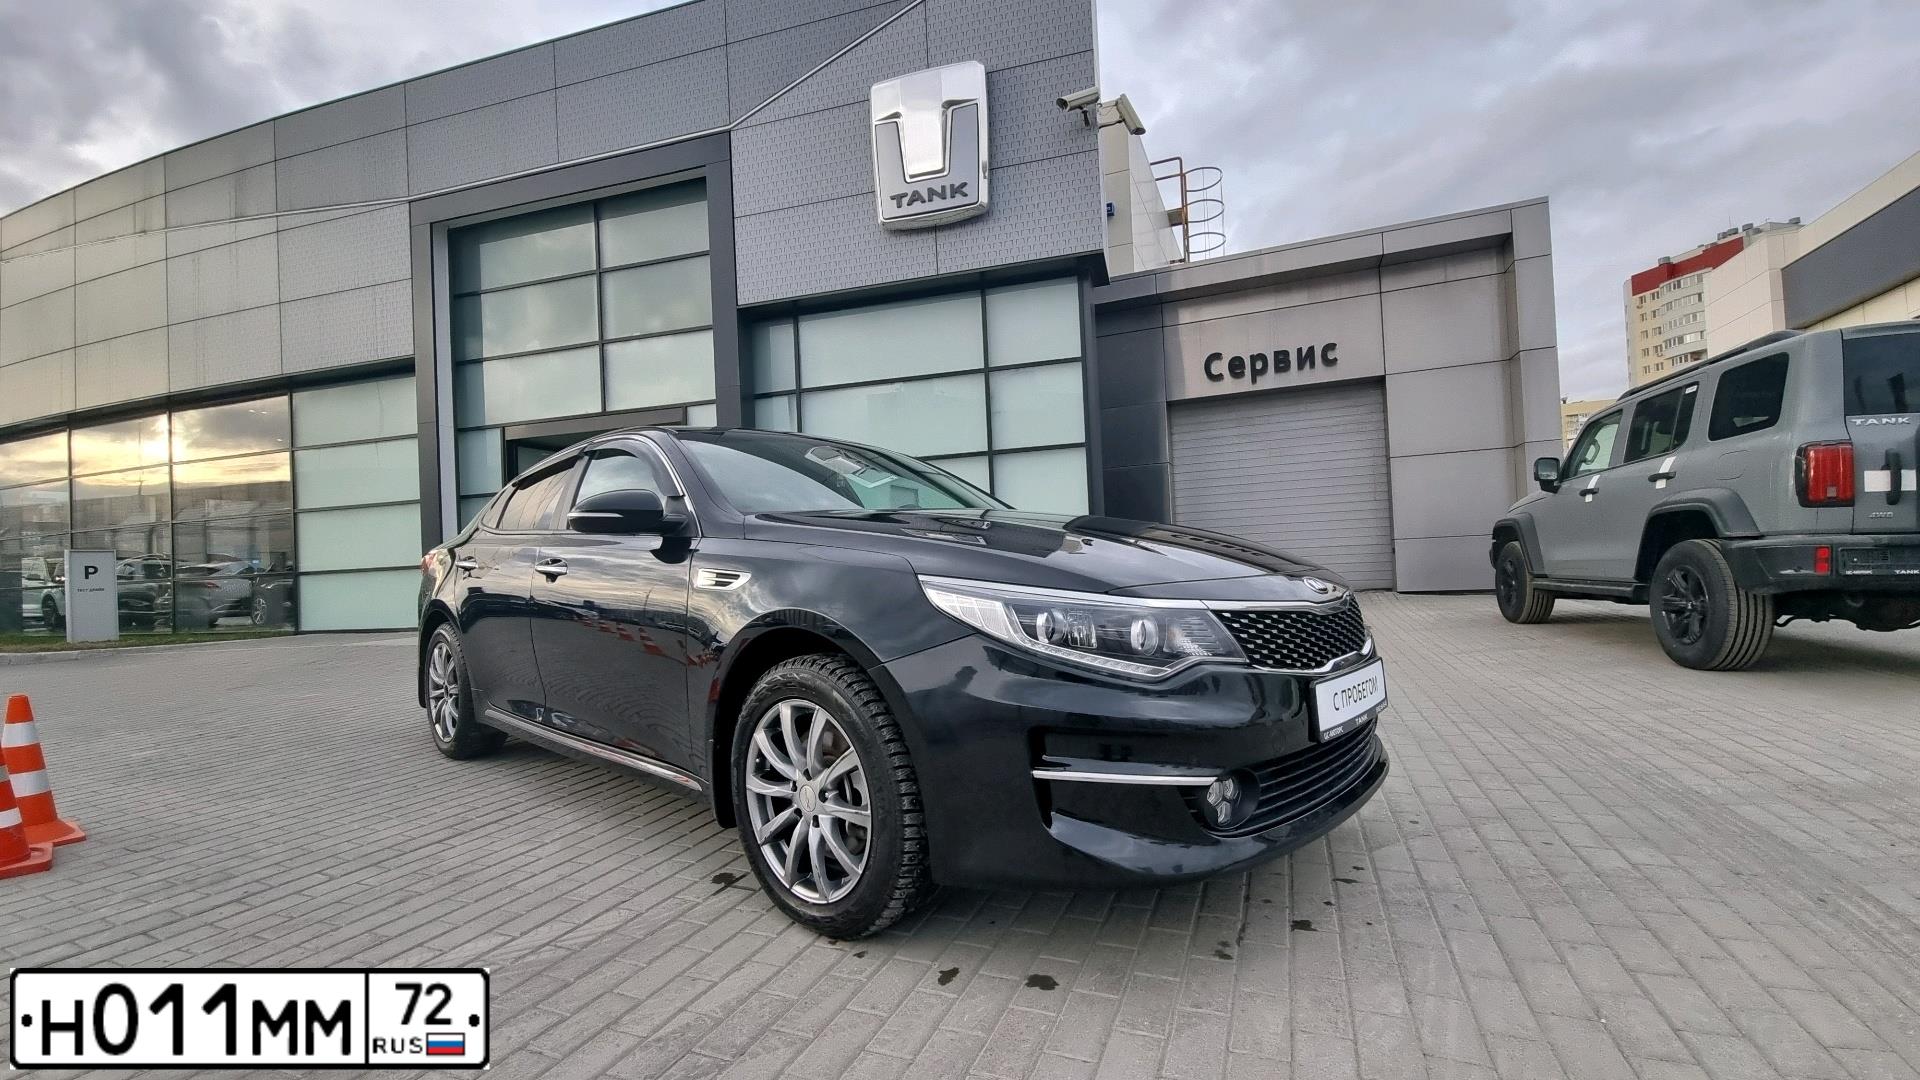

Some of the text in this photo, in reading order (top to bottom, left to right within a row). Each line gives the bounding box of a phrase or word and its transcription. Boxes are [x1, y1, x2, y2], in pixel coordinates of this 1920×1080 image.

[890, 181, 969, 208] TANK
[1204, 342, 1338, 385] Сервис
[1851, 416, 1911, 426] TANK
[84, 565, 98, 580] P
[1333, 692, 1340, 711] С
[1341, 675, 1379, 708] ПРОБЕГОМ
